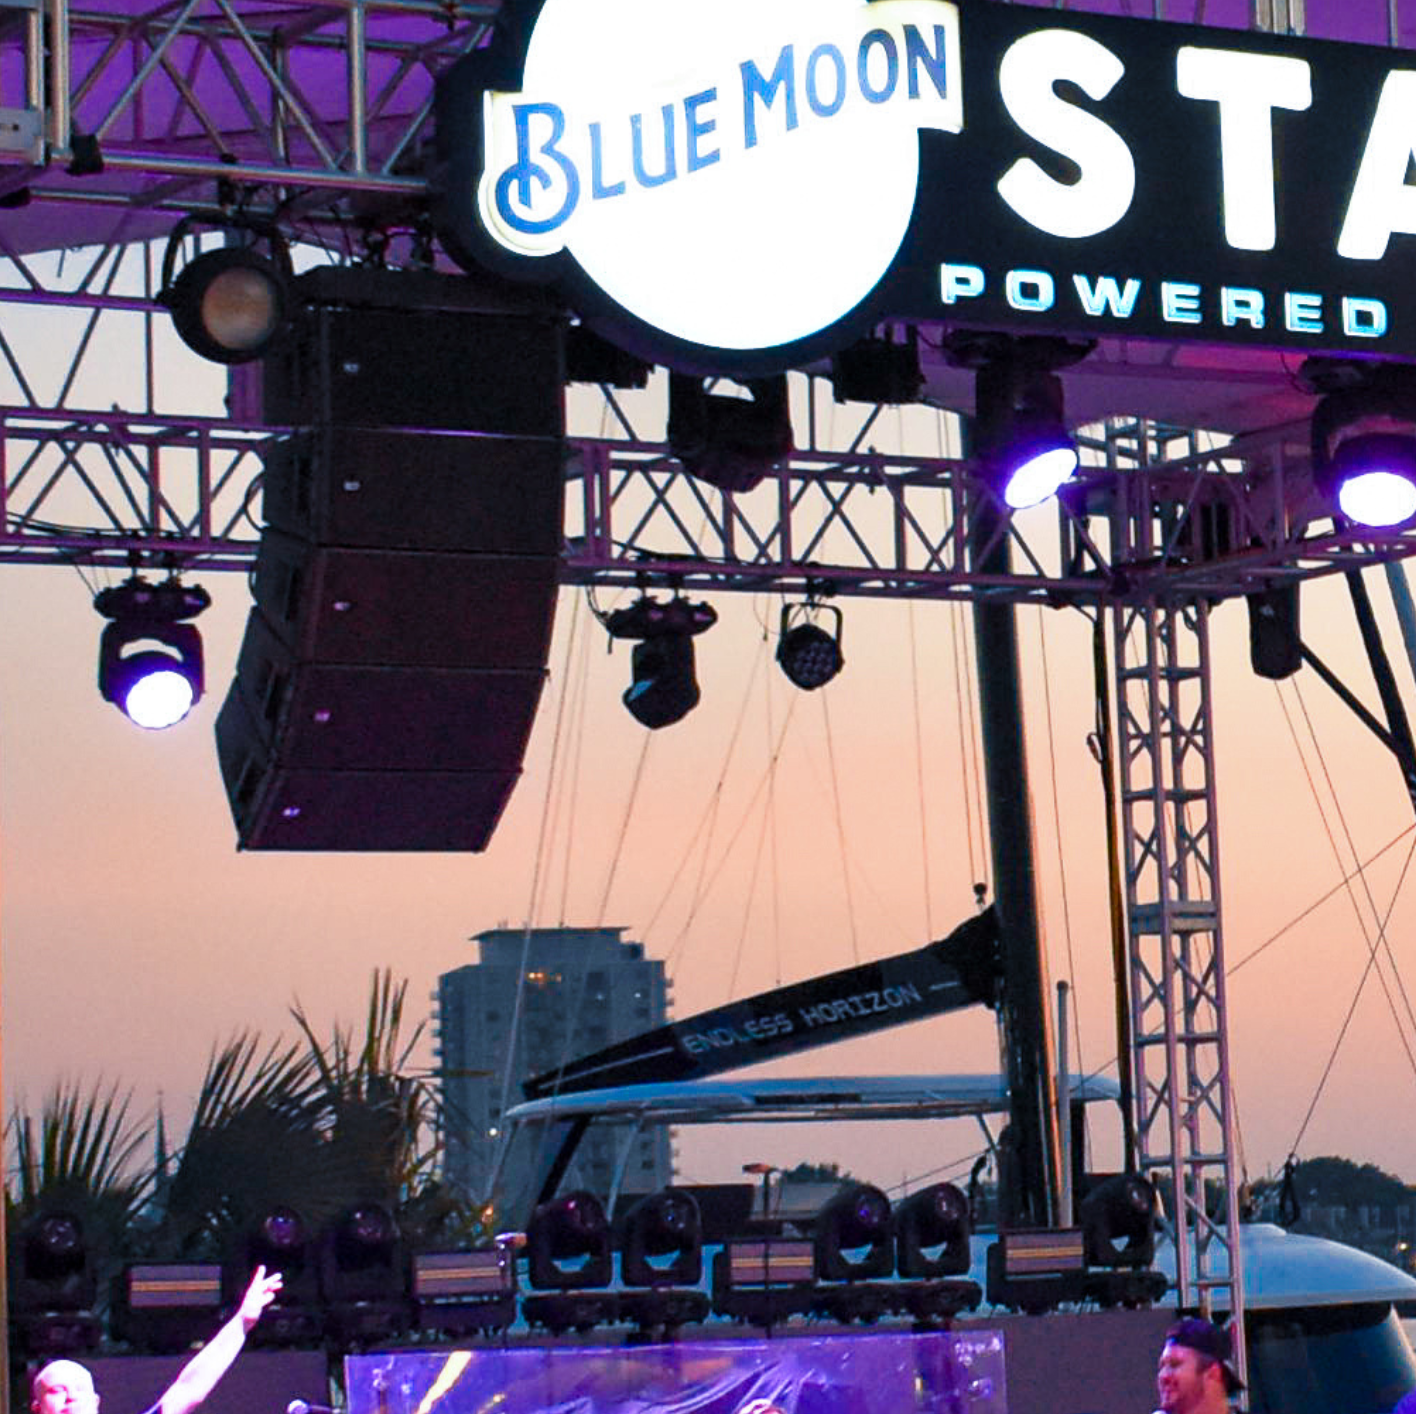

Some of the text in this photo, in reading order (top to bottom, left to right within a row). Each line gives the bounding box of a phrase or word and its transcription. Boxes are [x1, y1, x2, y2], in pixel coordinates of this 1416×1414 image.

[494, 23, 948, 235] BLUE MOON
[939, 263, 1388, 338] POWERED
[682, 982, 923, 1054] ENDLESS HORIZON
